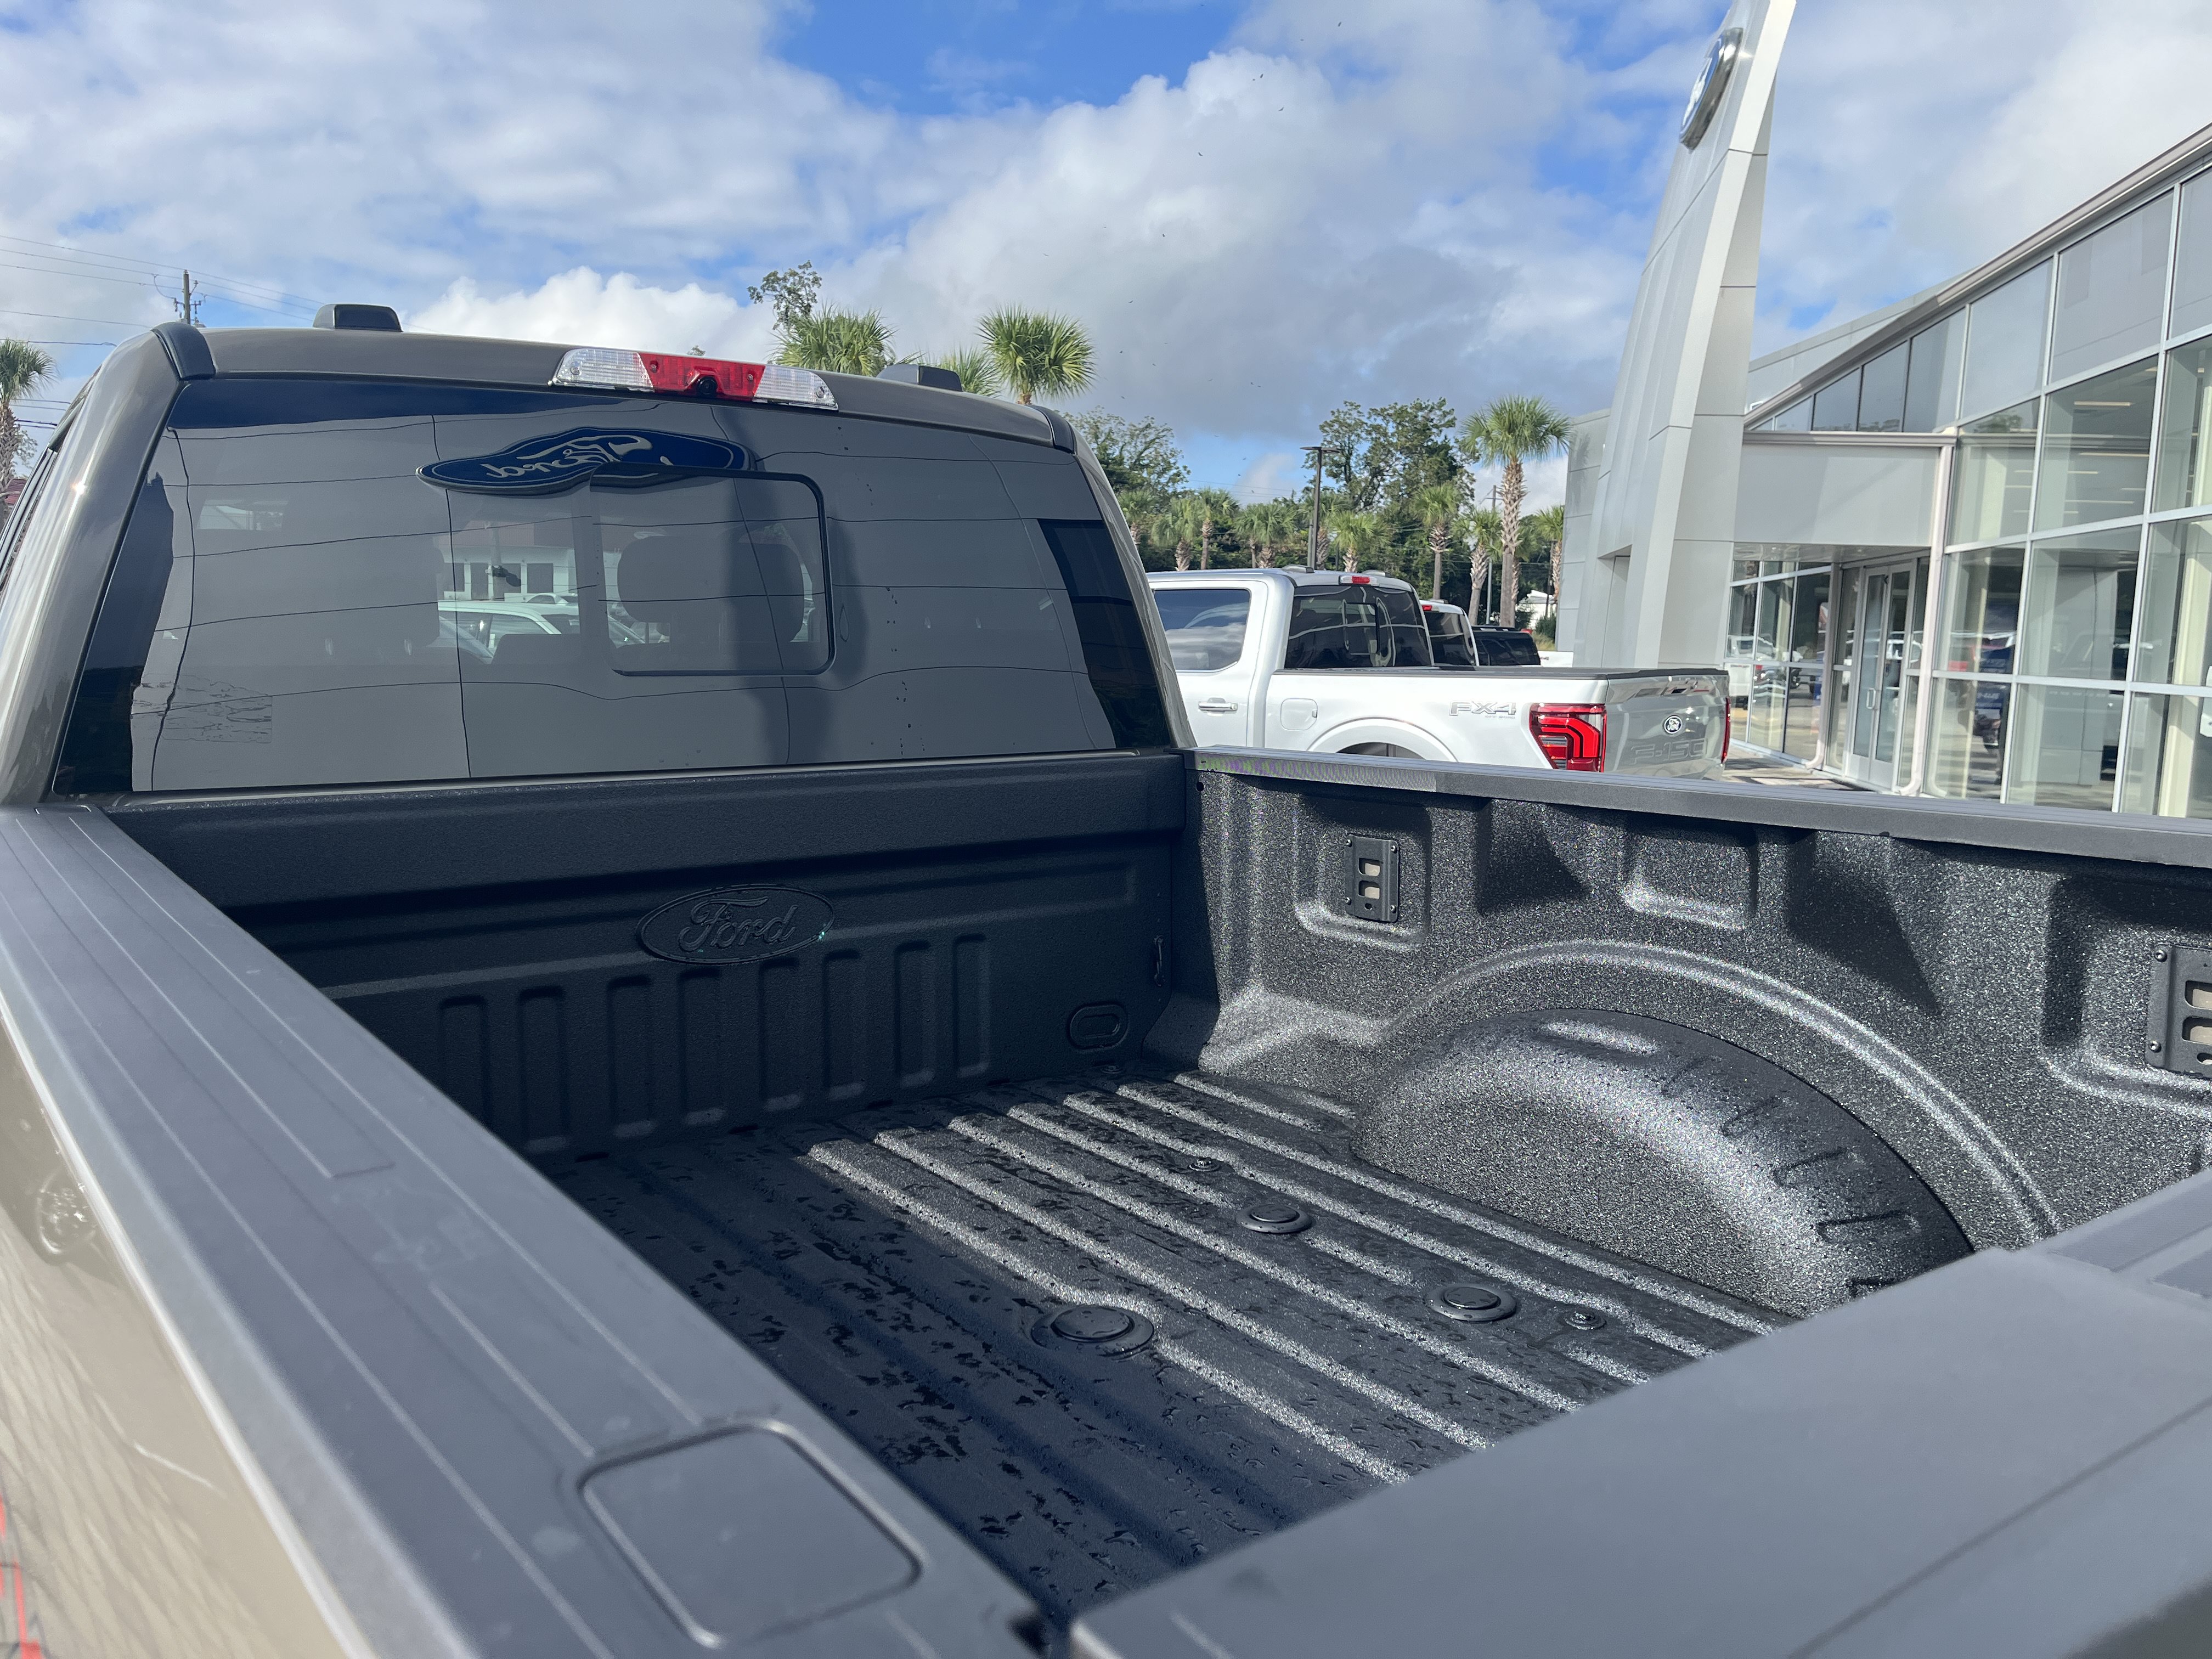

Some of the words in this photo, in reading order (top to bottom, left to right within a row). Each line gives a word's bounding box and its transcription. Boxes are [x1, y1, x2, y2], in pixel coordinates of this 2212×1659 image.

[1449, 701, 1516, 716] FX4
[1629, 738, 1708, 765] F-150
[679, 896, 798, 952] Ford
